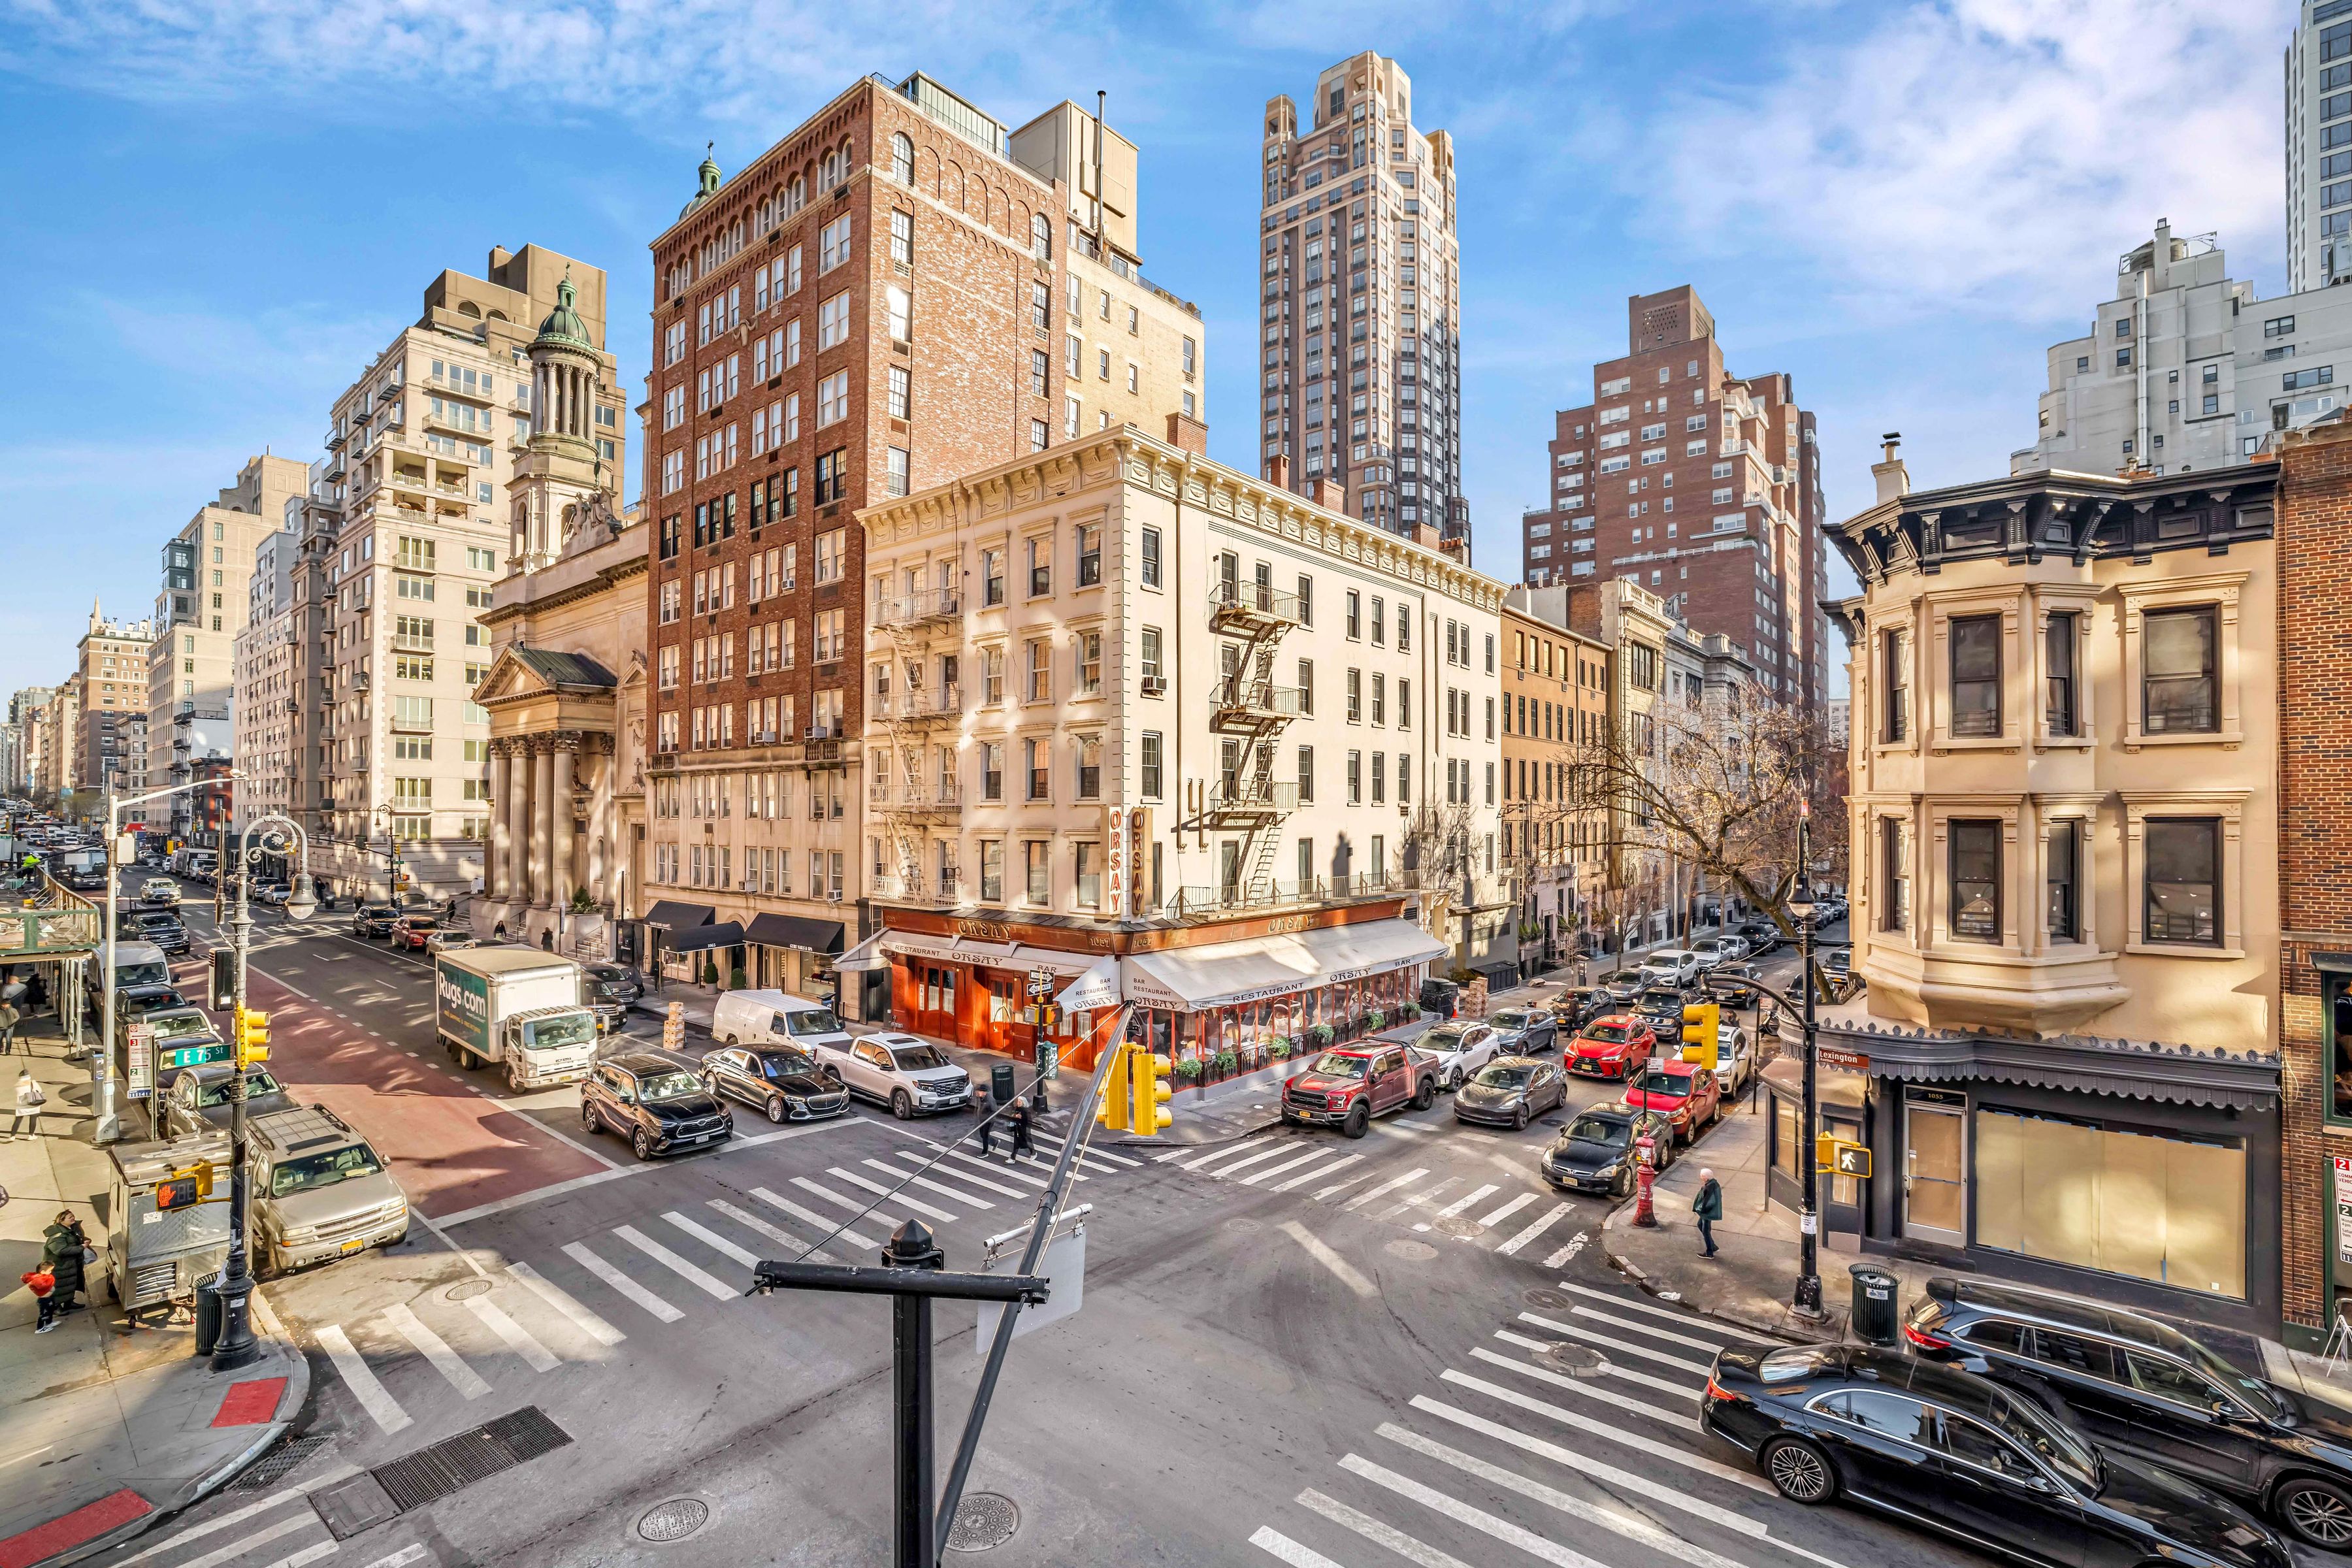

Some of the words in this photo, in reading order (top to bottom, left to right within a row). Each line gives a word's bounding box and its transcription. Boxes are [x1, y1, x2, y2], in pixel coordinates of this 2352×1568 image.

[1111, 811, 1121, 911] ORSAY
[1132, 811, 1144, 911] ORSAY
[1267, 914, 1313, 933] ORSAY
[958, 921, 1011, 939] ORSAY
[1090, 938, 1110, 947] 1057
[1134, 937, 1154, 947] 1057
[895, 945, 940, 956] RESTAURANT
[952, 953, 1003, 966] ORSAY
[1233, 982, 1304, 1002] RESTAURANT
[1330, 968, 1371, 982] ORSAY
[1395, 959, 1411, 968] BAR
[439, 971, 486, 1017] Rugs.com
[1076, 985, 1111, 996] RESTAURANT
[1134, 986, 1171, 996] RESTAURANT
[1075, 996, 1113, 1008] ORSAY
[1134, 996, 1177, 1009] ORSAY
[184, 1051, 190, 1063] E
[197, 1049, 212, 1062] 75
[1820, 1051, 1857, 1063] Lexington
[2339, 1160, 2347, 1169] 2
[2342, 1205, 2349, 1215] 2
[2342, 1254, 2352, 1262] 11
